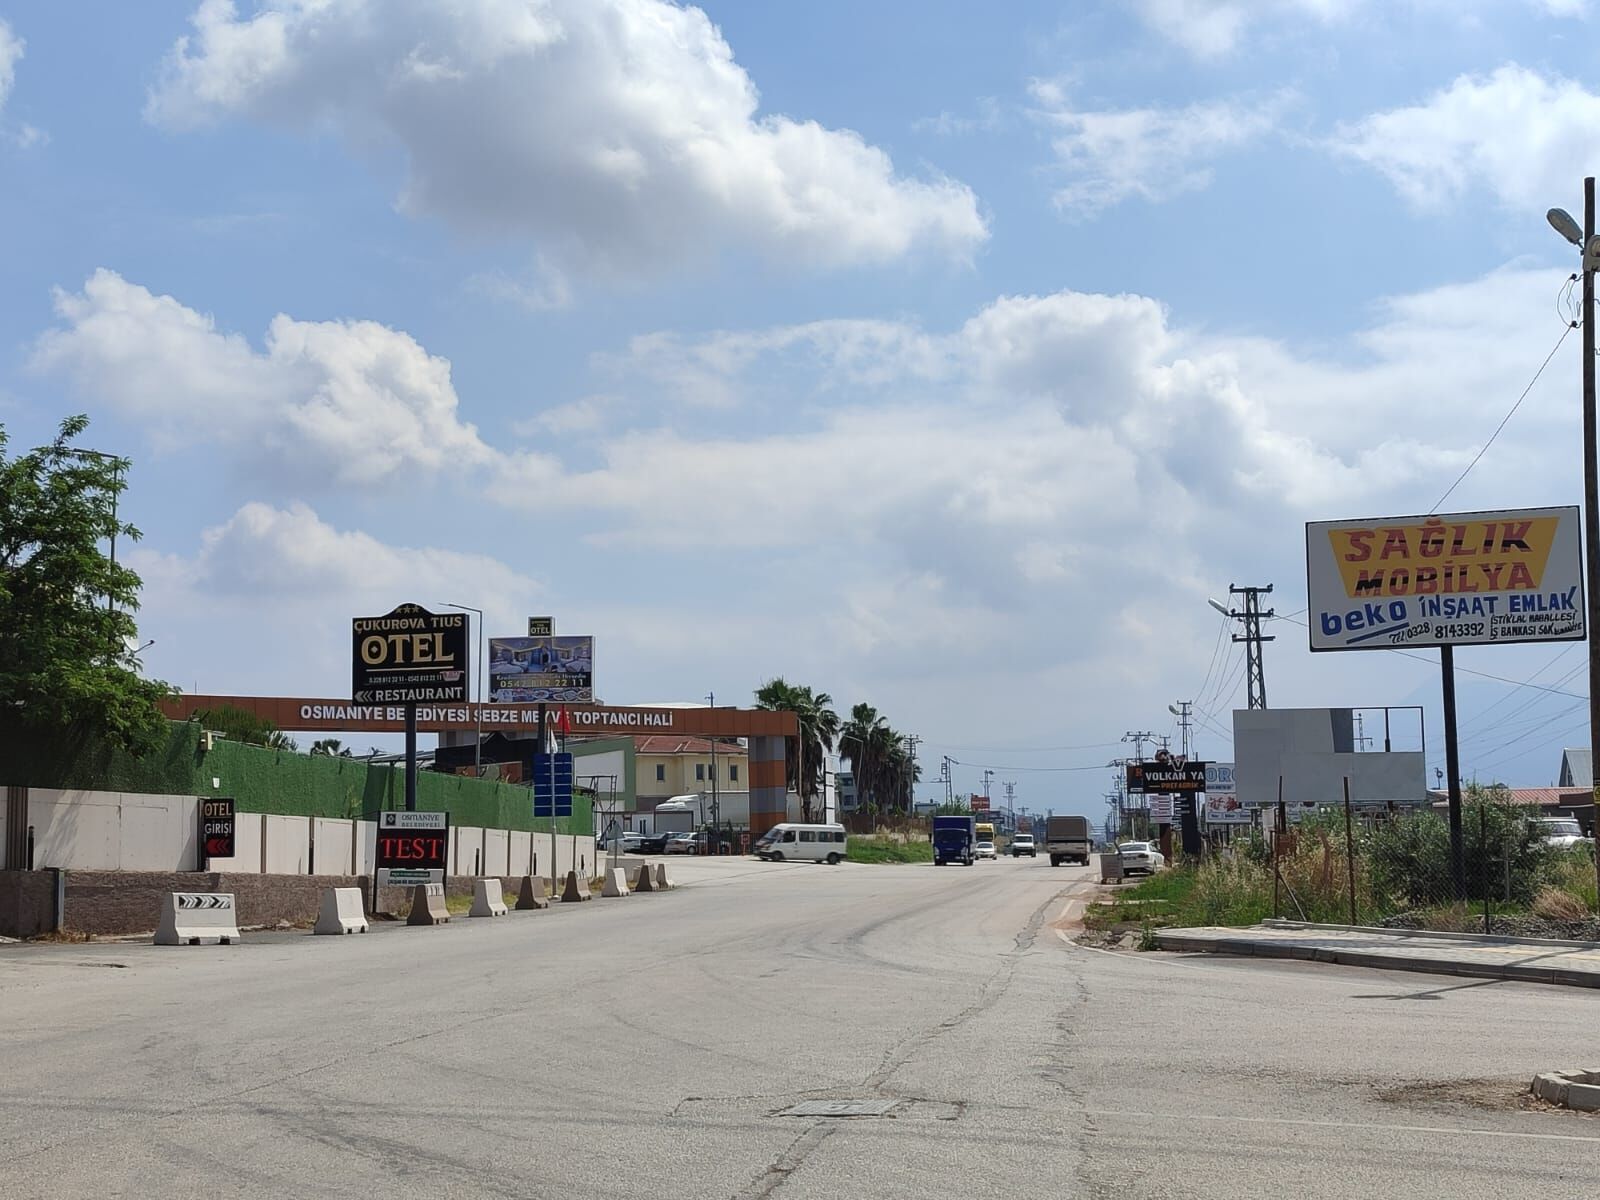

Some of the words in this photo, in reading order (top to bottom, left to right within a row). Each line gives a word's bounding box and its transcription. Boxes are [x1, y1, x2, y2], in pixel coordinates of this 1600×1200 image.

[1344, 517, 1534, 563] SAĞLIK
[1353, 560, 1538, 597] MOBİLYA
[1418, 594, 1499, 619] İNŞAAT
[1509, 586, 1577, 613] EMLAK
[354, 618, 426, 635] ÇUKUROVA
[430, 616, 462, 628] TIUS
[1320, 600, 1410, 637] beko
[530, 626, 550, 635] OTEL
[1434, 622, 1485, 639] 8143392
[361, 633, 455, 665] OTEL
[531, 679, 551, 687] 12
[555, 679, 568, 687] 22
[572, 678, 584, 686] 11
[375, 686, 463, 702] RESTAURANT
[386, 705, 470, 722] BEEDİYESİ
[473, 708, 518, 723] SEBZE
[573, 711, 641, 726] TOPTANCI
[643, 711, 673, 727] HALİ
[1145, 771, 1186, 781] VOLKAN
[204, 802, 232, 817] OTEL
[204, 820, 232, 837] GİRİŞİ
[380, 838, 443, 859] TEST
